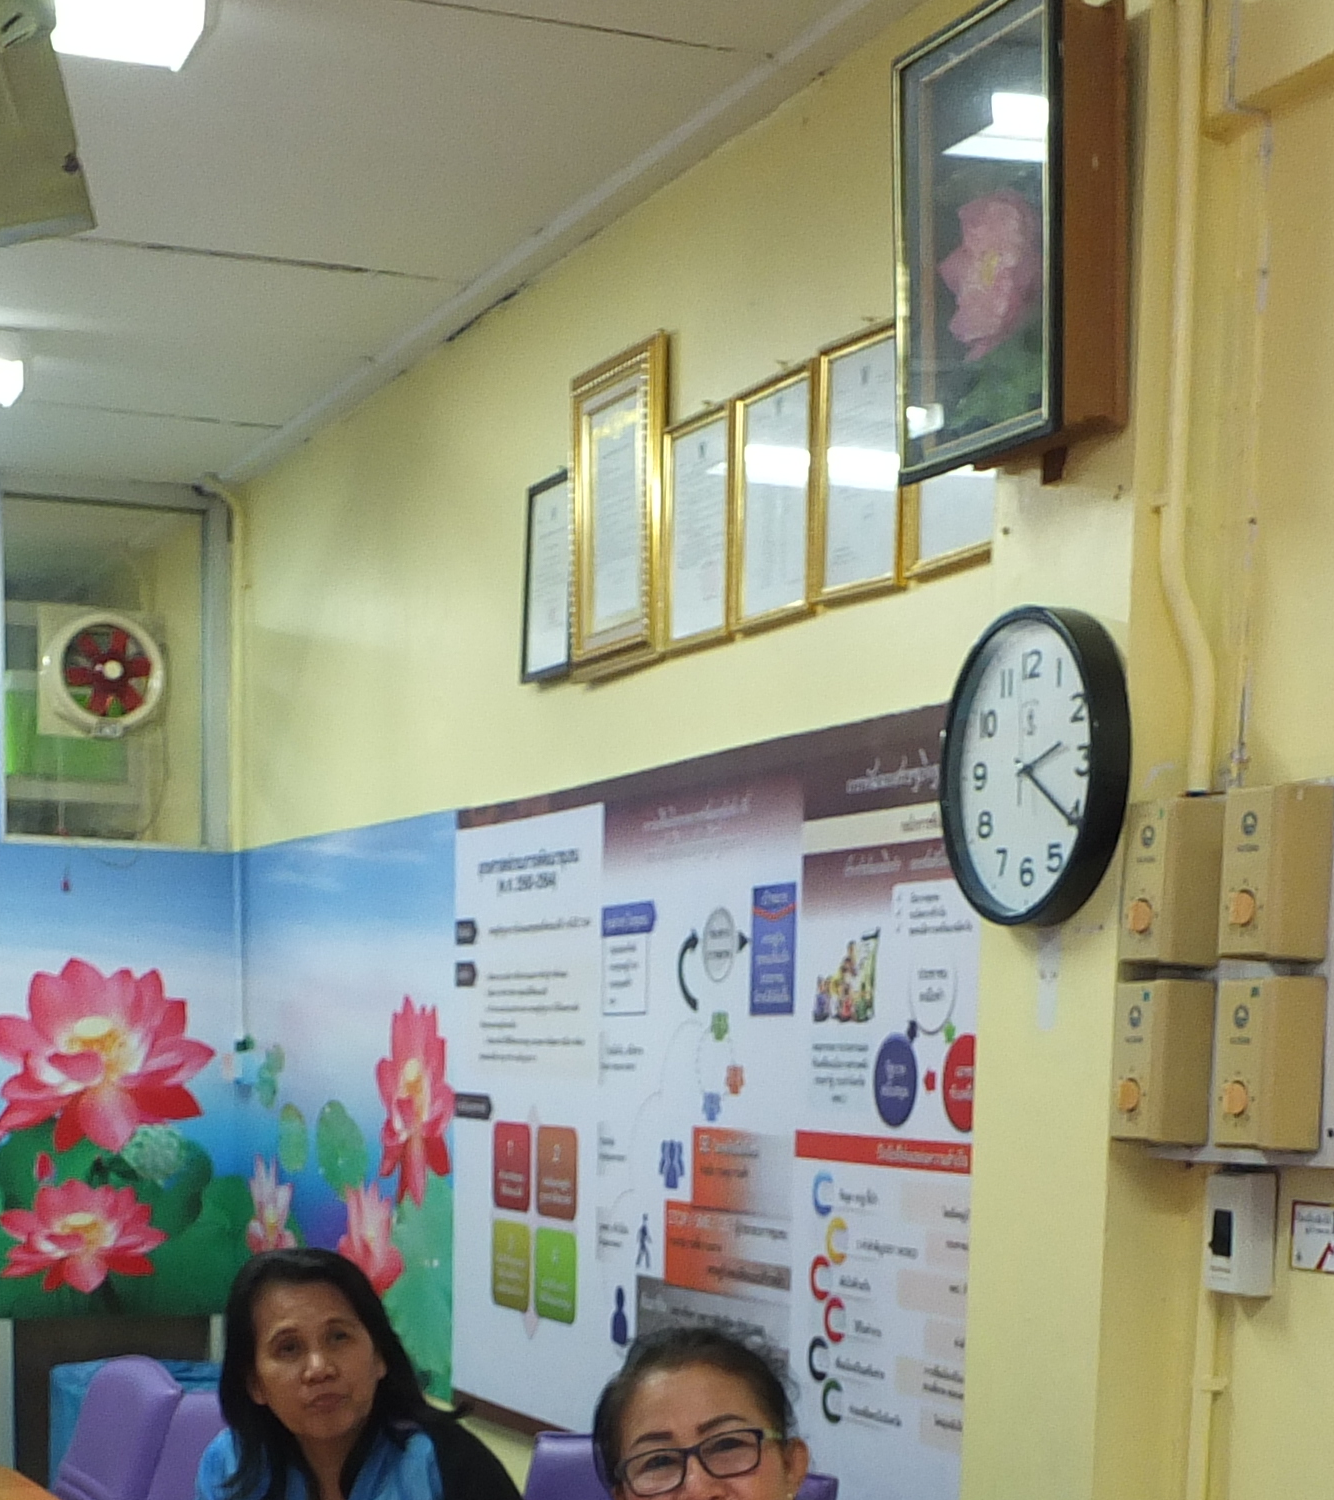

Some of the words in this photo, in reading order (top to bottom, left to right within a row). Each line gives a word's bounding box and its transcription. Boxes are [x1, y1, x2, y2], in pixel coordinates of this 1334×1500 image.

[1021, 649, 1043, 680] 12
[1055, 657, 1063, 688] 1
[1000, 667, 1014, 698] 11
[1070, 693, 1086, 723] 2
[979, 709, 998, 739] 10
[1074, 745, 1091, 777] 3
[972, 762, 988, 791] 9
[977, 811, 993, 839] 8
[995, 847, 1008, 877] 7
[1019, 857, 1034, 887] 6
[1046, 843, 1063, 873] 5
